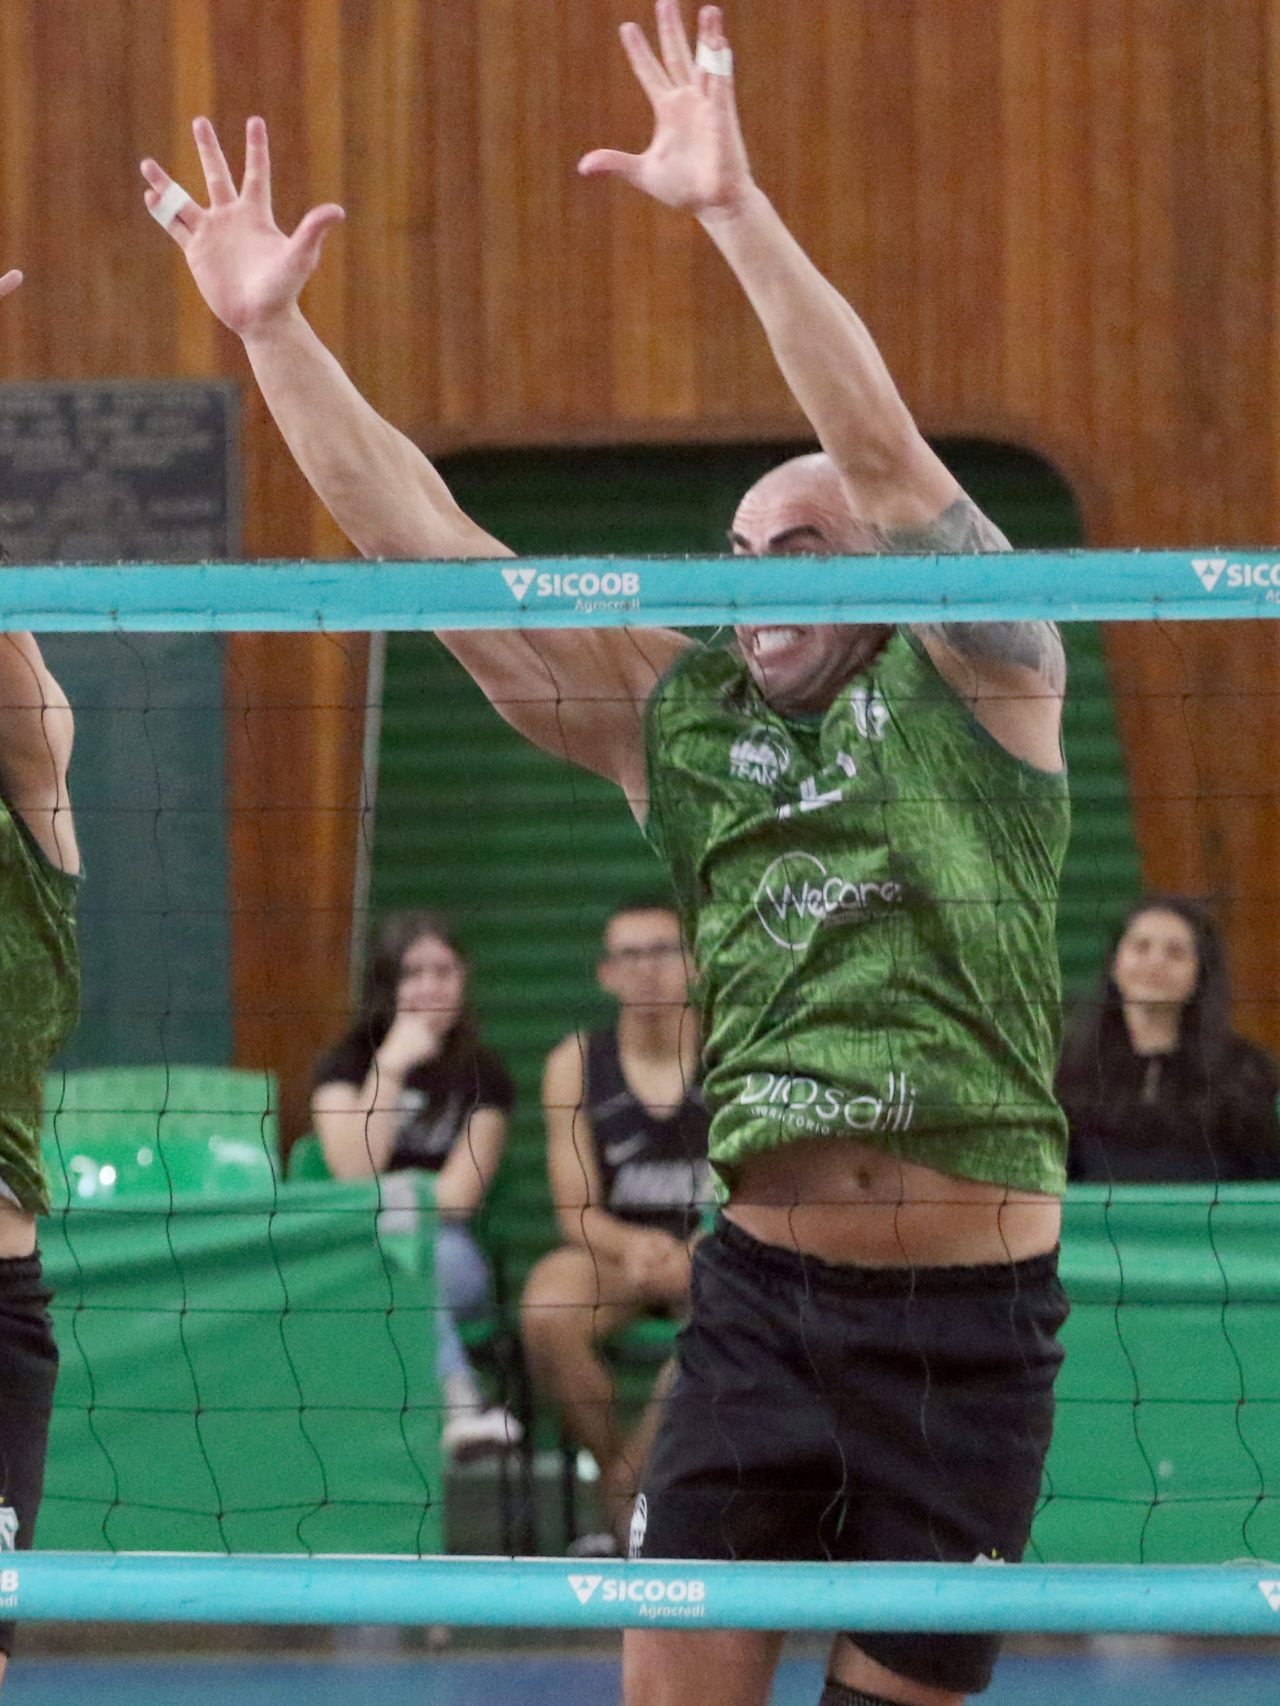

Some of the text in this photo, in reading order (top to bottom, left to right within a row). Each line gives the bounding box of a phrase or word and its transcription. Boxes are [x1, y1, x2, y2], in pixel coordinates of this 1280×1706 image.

[537, 572, 640, 597] SICOOB
[574, 599, 640, 614] Agrocredi
[766, 876, 902, 920] WeCare
[602, 1579, 705, 1602] SICOOB
[638, 1603, 705, 1619] Agrocredi
